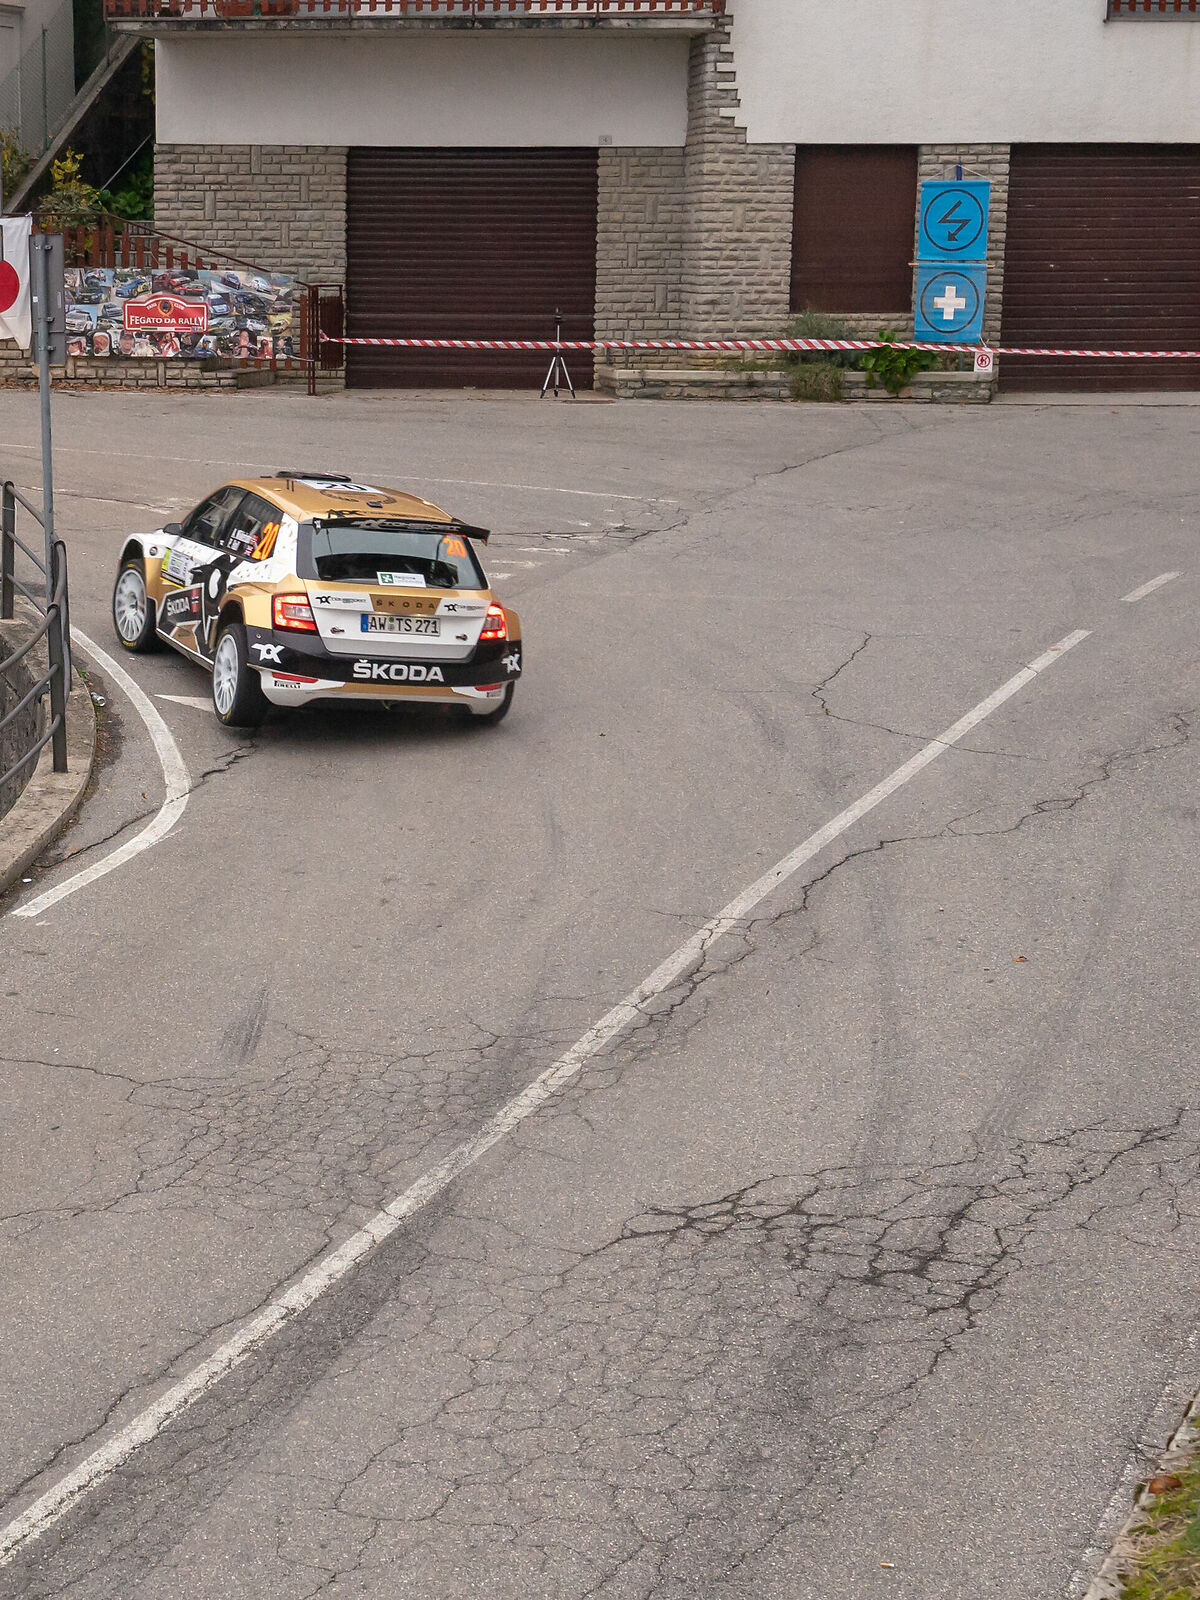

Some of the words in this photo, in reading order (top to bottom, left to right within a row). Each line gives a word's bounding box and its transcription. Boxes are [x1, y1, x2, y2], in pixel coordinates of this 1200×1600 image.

[129, 315, 162, 325] FEGATO
[178, 316, 204, 325] RALLY
[251, 521, 280, 560] 20
[442, 537, 467, 558] 20
[166, 596, 191, 616] ŠKODA
[369, 618, 387, 631] AW
[395, 618, 412, 632] TS
[415, 619, 439, 634] 271
[352, 659, 445, 682] ŠKODA
